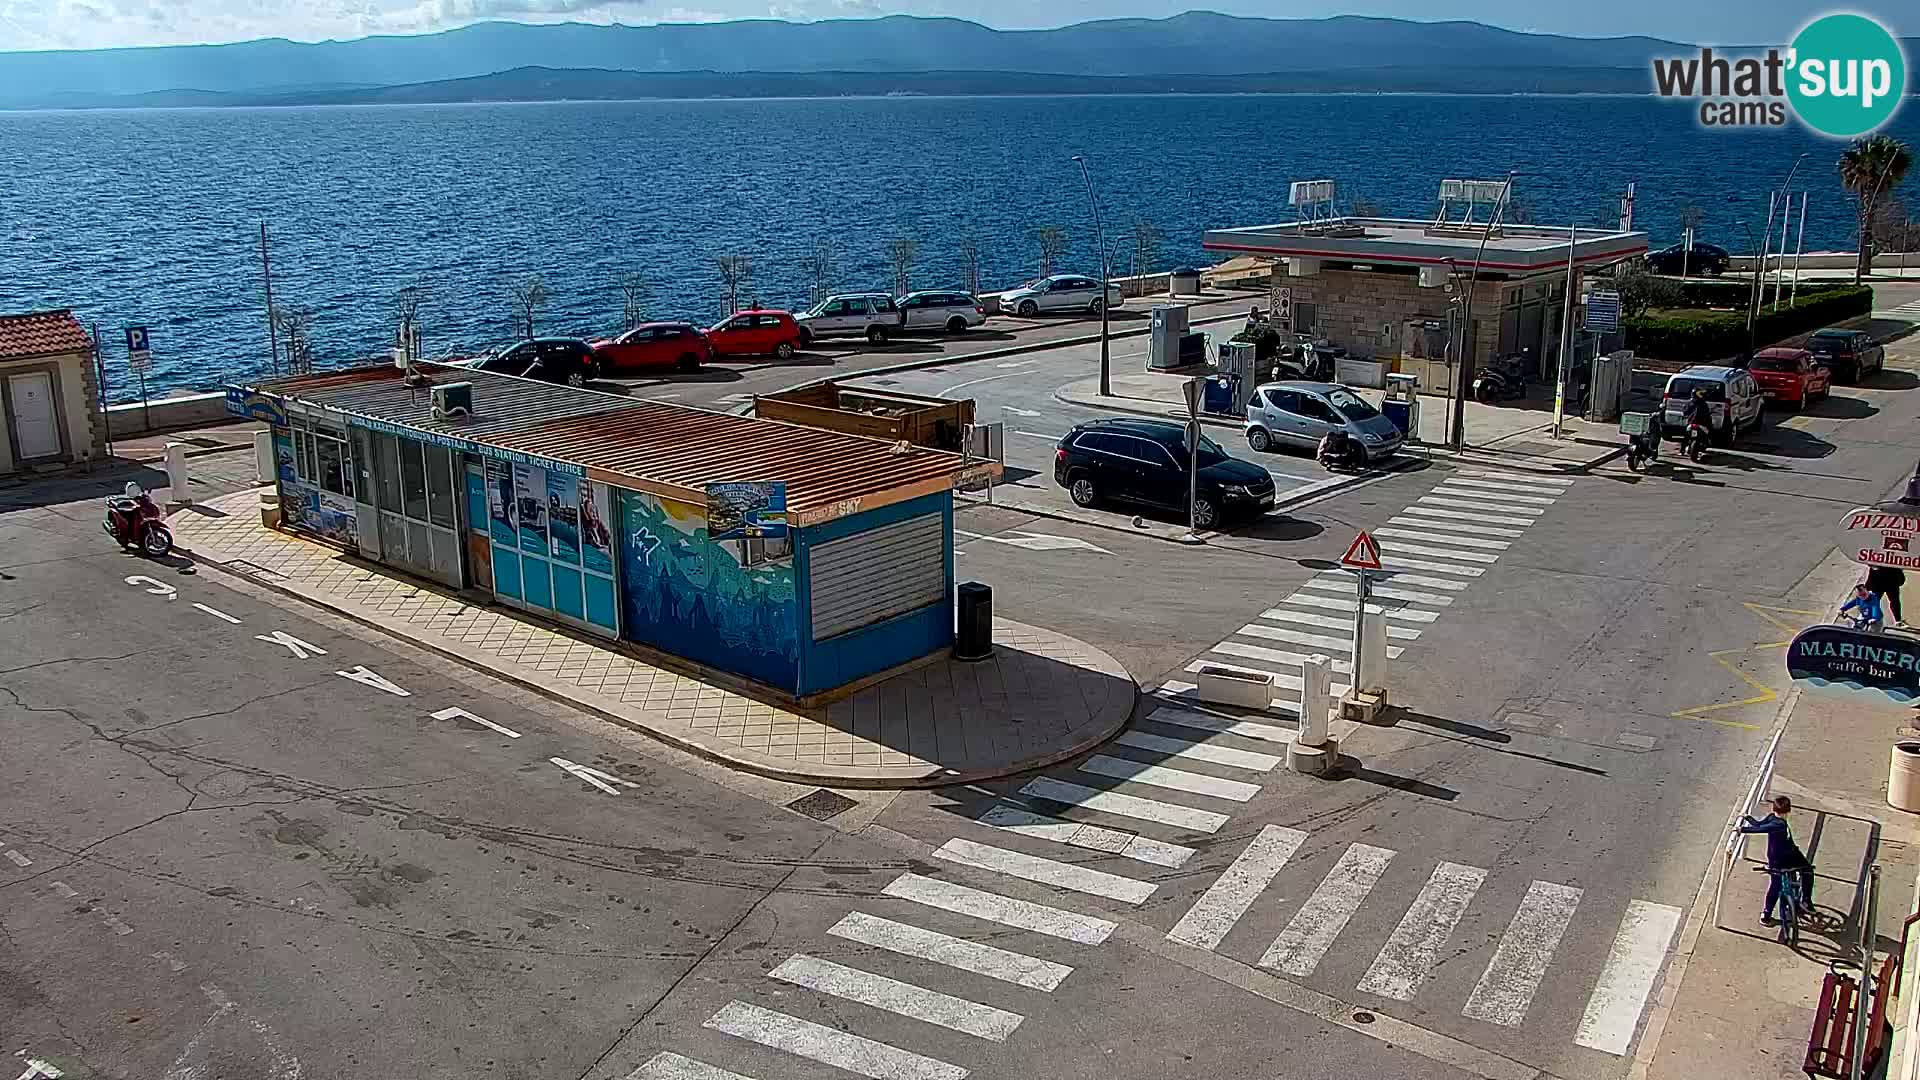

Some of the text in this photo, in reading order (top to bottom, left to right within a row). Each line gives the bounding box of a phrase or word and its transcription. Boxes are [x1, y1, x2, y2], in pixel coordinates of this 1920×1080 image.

[131, 330, 143, 348] P
[396, 427, 436, 443] AUTOBUSNA
[437, 437, 468, 450] POSTAJA
[478, 444, 493, 455] BUS
[494, 448, 527, 463] STATION
[529, 455, 555, 471] TICKET
[555, 460, 582, 476] OFFICE
[1847, 514, 1920, 532] PIZZE
[1881, 529, 1914, 540] GRILL
[1828, 661, 1896, 679] caffe bar
